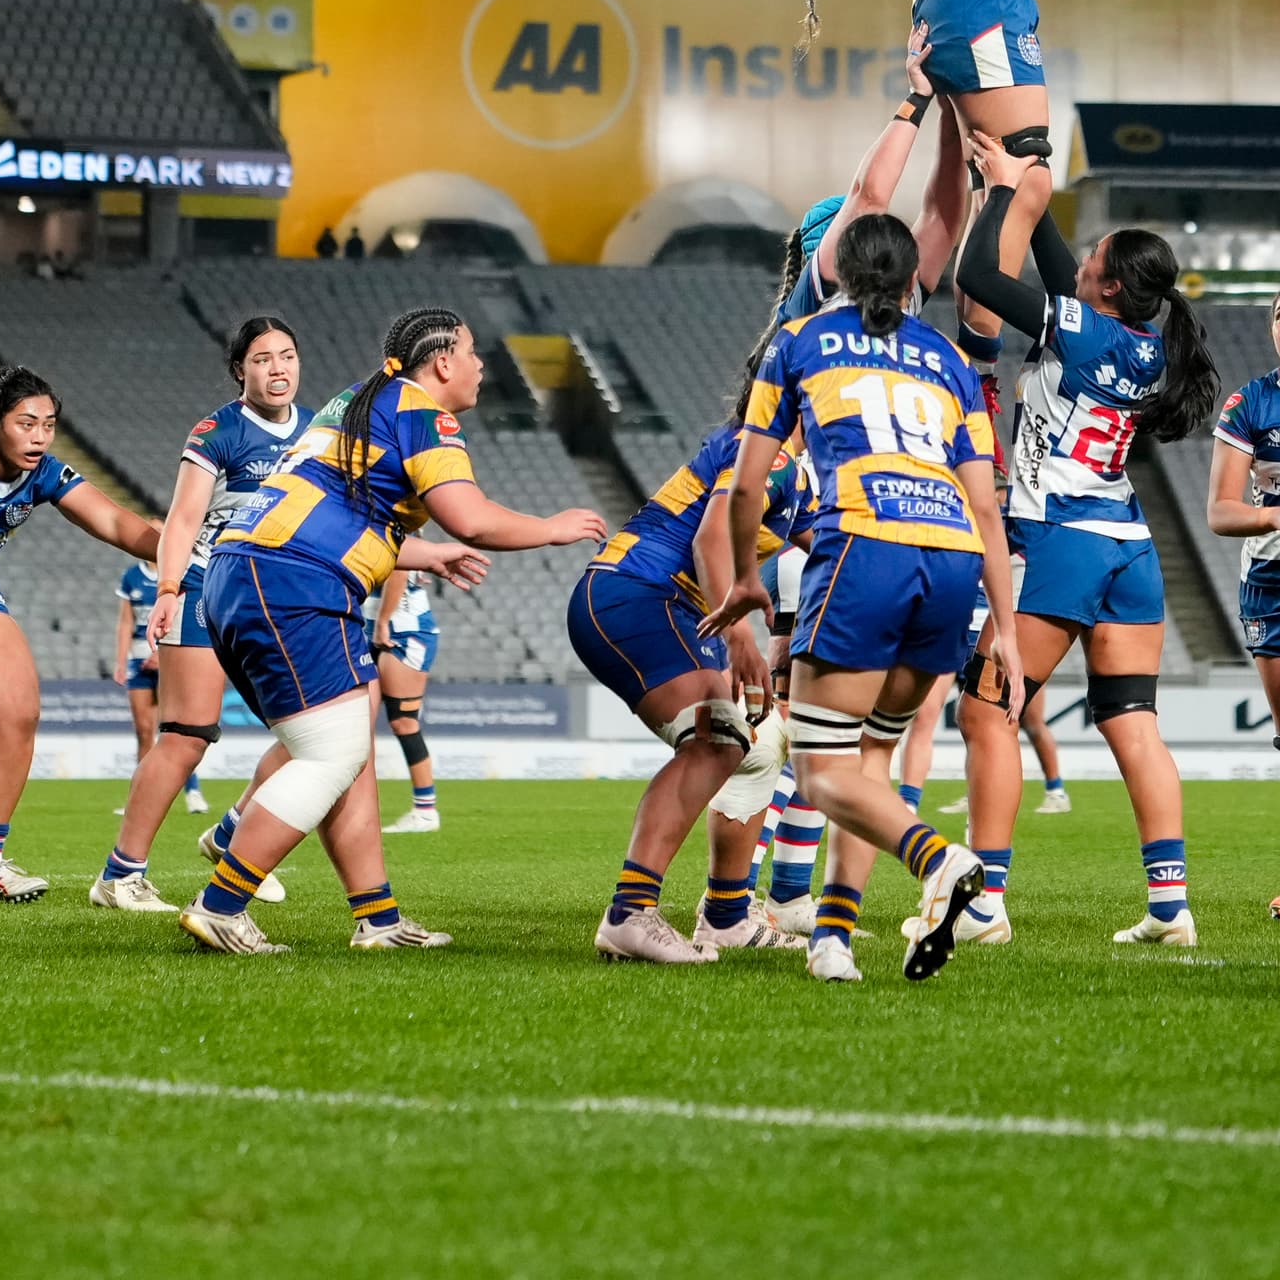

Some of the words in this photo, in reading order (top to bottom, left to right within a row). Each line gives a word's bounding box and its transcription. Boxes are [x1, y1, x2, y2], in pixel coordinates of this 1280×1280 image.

[492, 24, 601, 94] AA
[19, 149, 108, 181] EDEN
[115, 154, 205, 186] PARK
[216, 162, 273, 186] NEW
[819, 332, 942, 373] DUNES
[839, 374, 948, 464] 19
[898, 500, 952, 517] FLOORS
